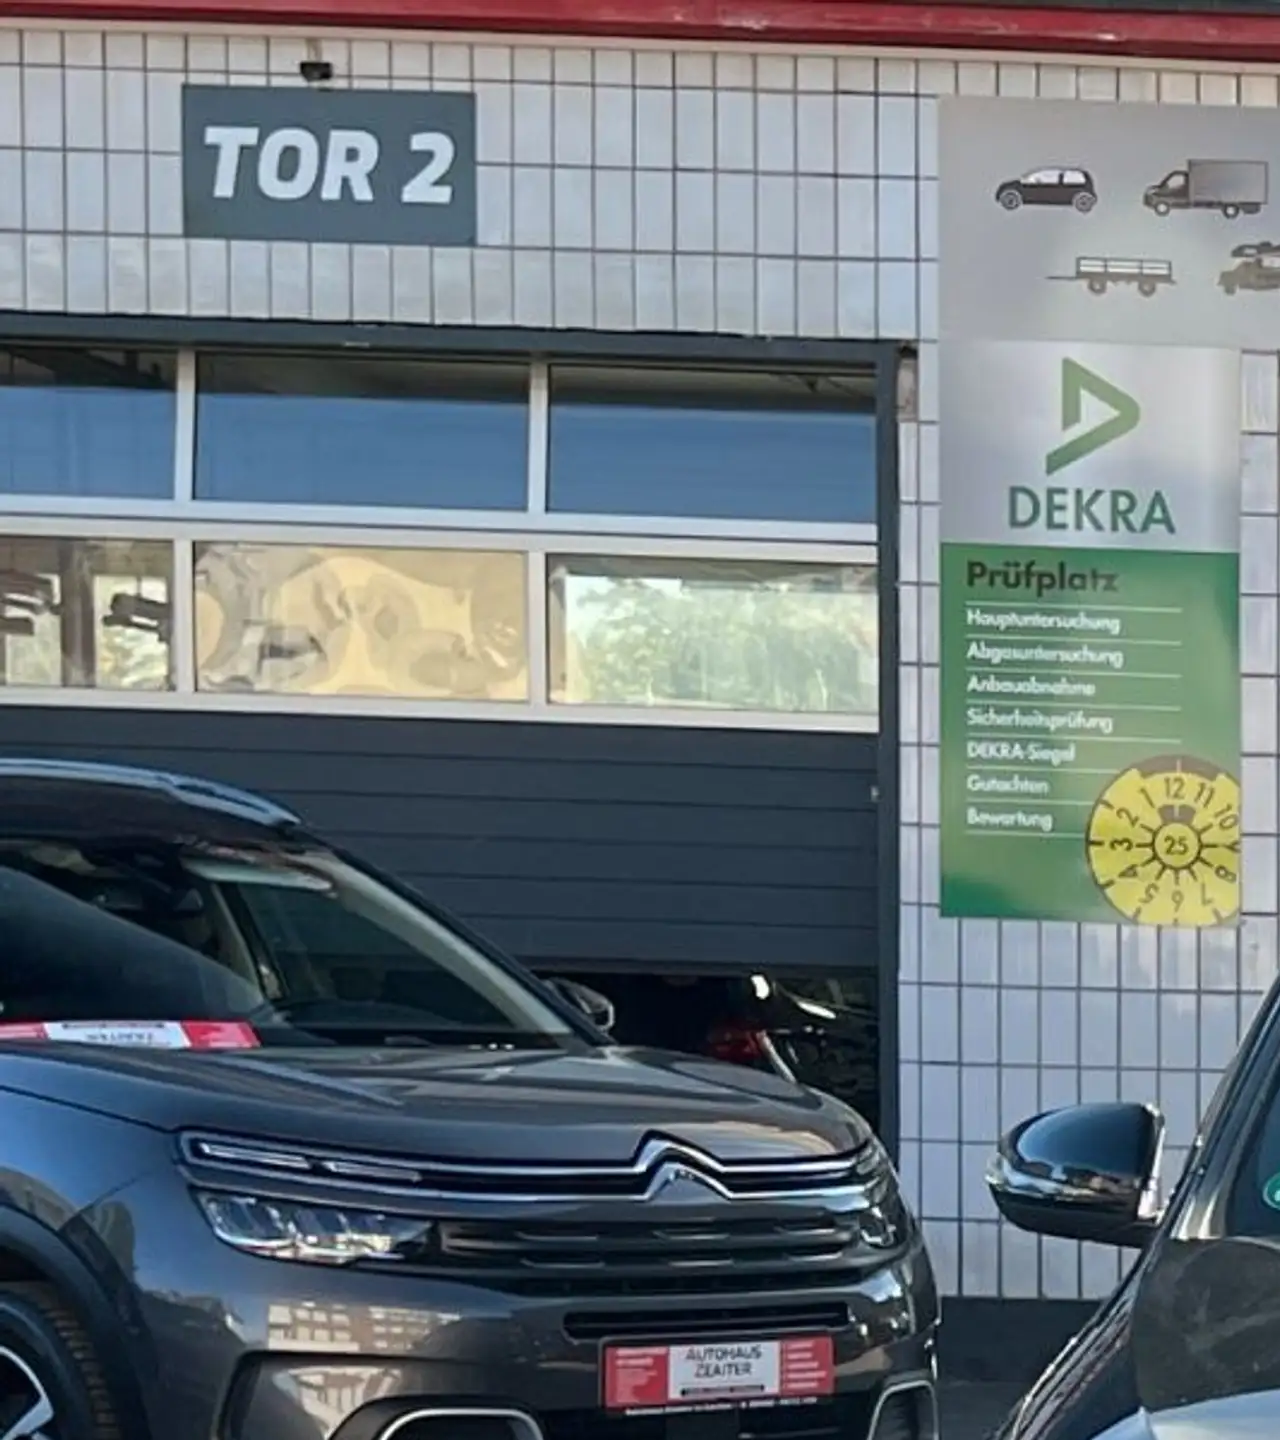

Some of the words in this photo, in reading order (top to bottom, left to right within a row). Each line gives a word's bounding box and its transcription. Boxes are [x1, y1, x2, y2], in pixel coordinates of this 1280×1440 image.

[204, 126, 379, 201] TOR
[401, 131, 454, 204] 2
[1008, 485, 1176, 535] DEKRA
[966, 560, 1119, 598] Prüfplatz
[966, 608, 1121, 635] Hauptuntersuchung
[966, 641, 1124, 669] Abgasuntersuchung
[966, 675, 1096, 697] Anbauabnahme
[966, 707, 1114, 734] Sicherheitsprüfung
[966, 774, 1049, 796] Gutachten
[1164, 777, 1185, 800] 12
[1194, 782, 1215, 808] 11
[1139, 786, 1155, 809] 1
[966, 807, 1053, 831] Bewertung
[1116, 806, 1139, 828] 2
[1213, 804, 1239, 831] 10
[1110, 837, 1134, 851] 3
[1164, 834, 1189, 856] 25
[1118, 864, 1139, 879] 4
[1215, 865, 1238, 884] 8
[685, 1345, 762, 1361] AUTOHAUS
[694, 1363, 752, 1379] ZEAITER
